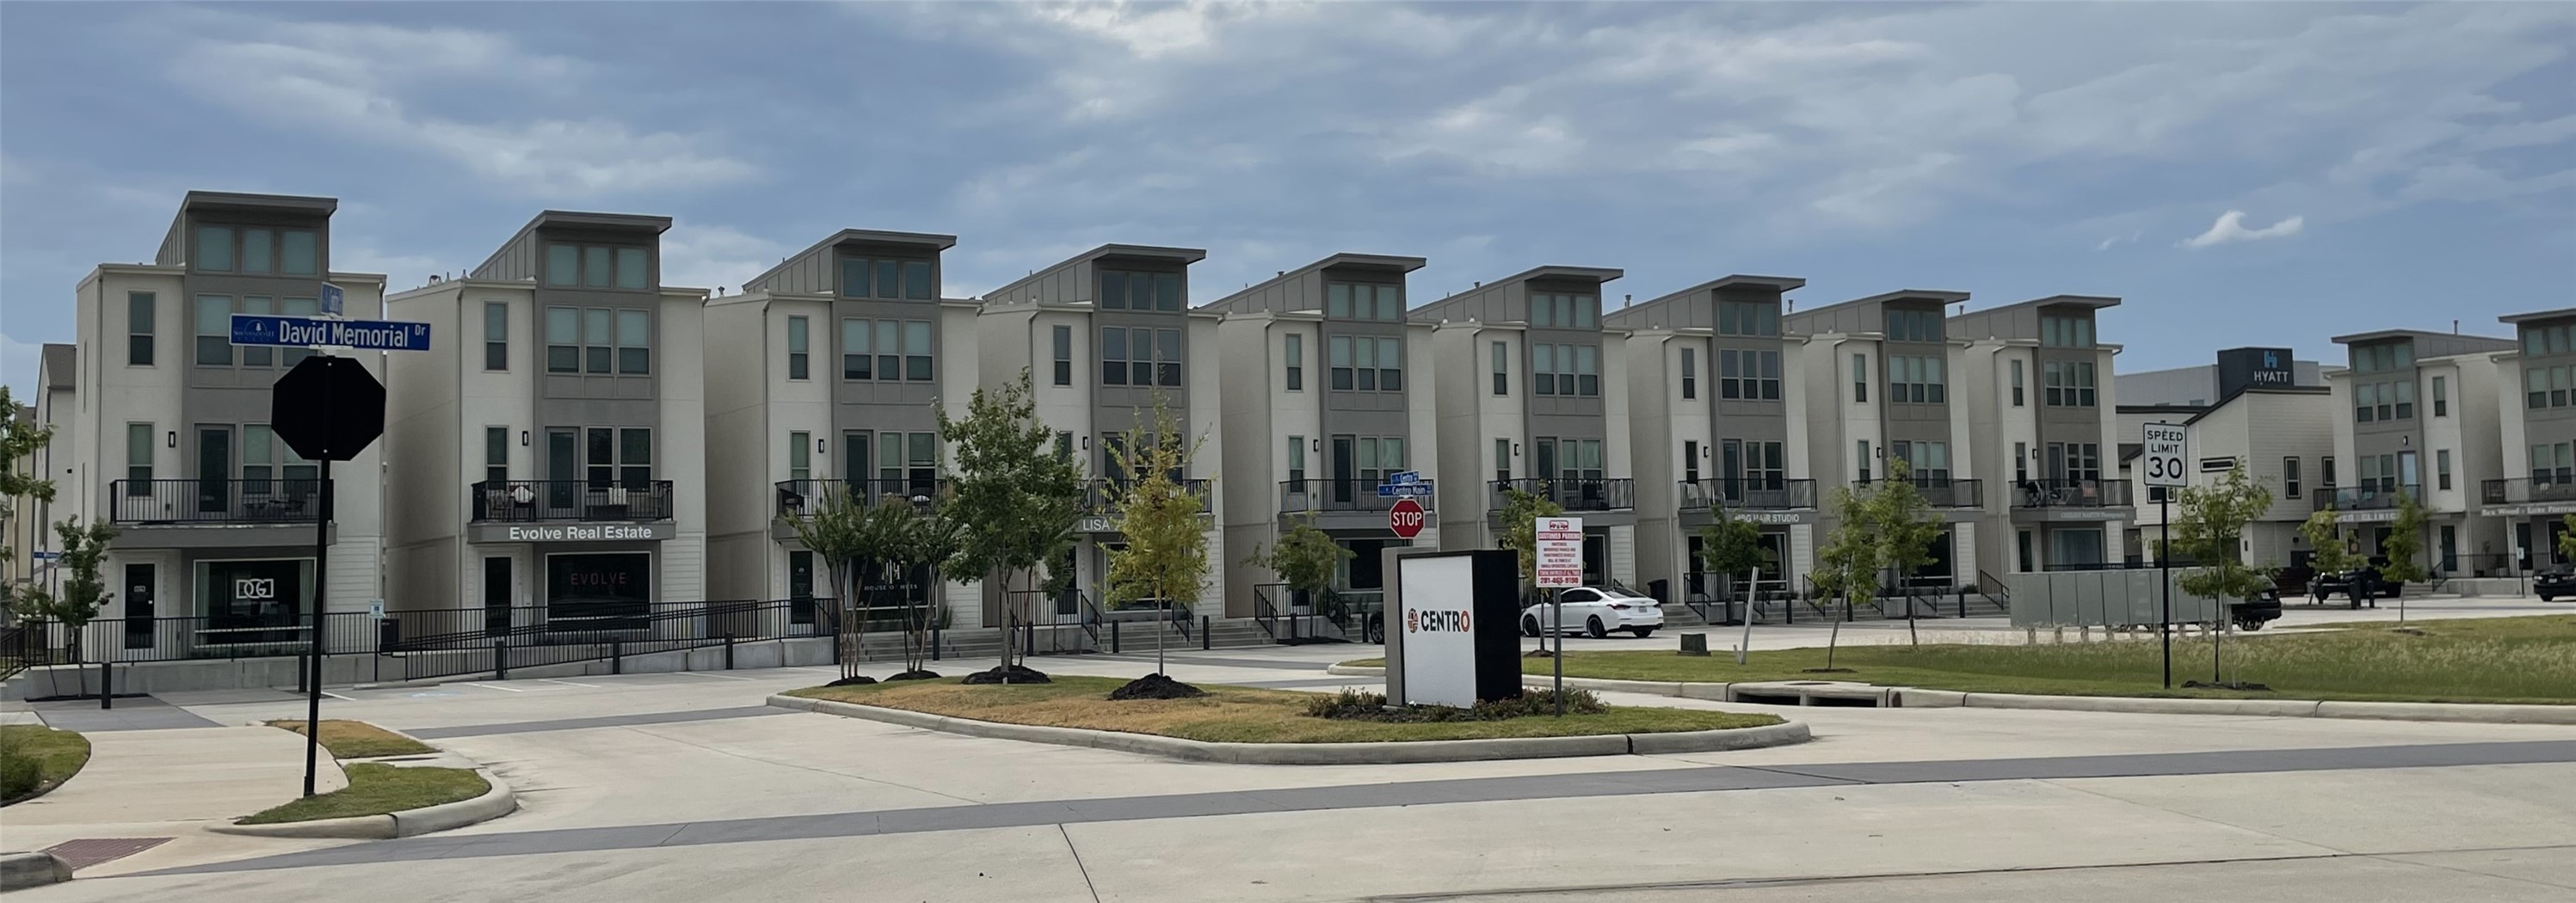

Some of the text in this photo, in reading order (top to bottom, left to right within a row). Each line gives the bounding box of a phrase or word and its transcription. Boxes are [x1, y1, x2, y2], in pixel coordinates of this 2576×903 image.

[279, 320, 426, 347] David Memorial Dr
[2254, 371, 2289, 383] HYATT
[2147, 430, 2184, 441] SPEED
[2151, 443, 2179, 454] LIMIT
[2149, 456, 2183, 479] 30
[1392, 486, 1412, 495] Centro
[1412, 486, 1426, 494] Main
[2497, 507, 2520, 515] Wood
[1392, 512, 1422, 526] STOP
[1772, 513, 1800, 522] STUDIO
[1082, 519, 1111, 531] LISA
[509, 525, 652, 540] Evolve Real Estate
[570, 572, 626, 585] EVOLVE
[1420, 610, 1470, 632] CENTRO
